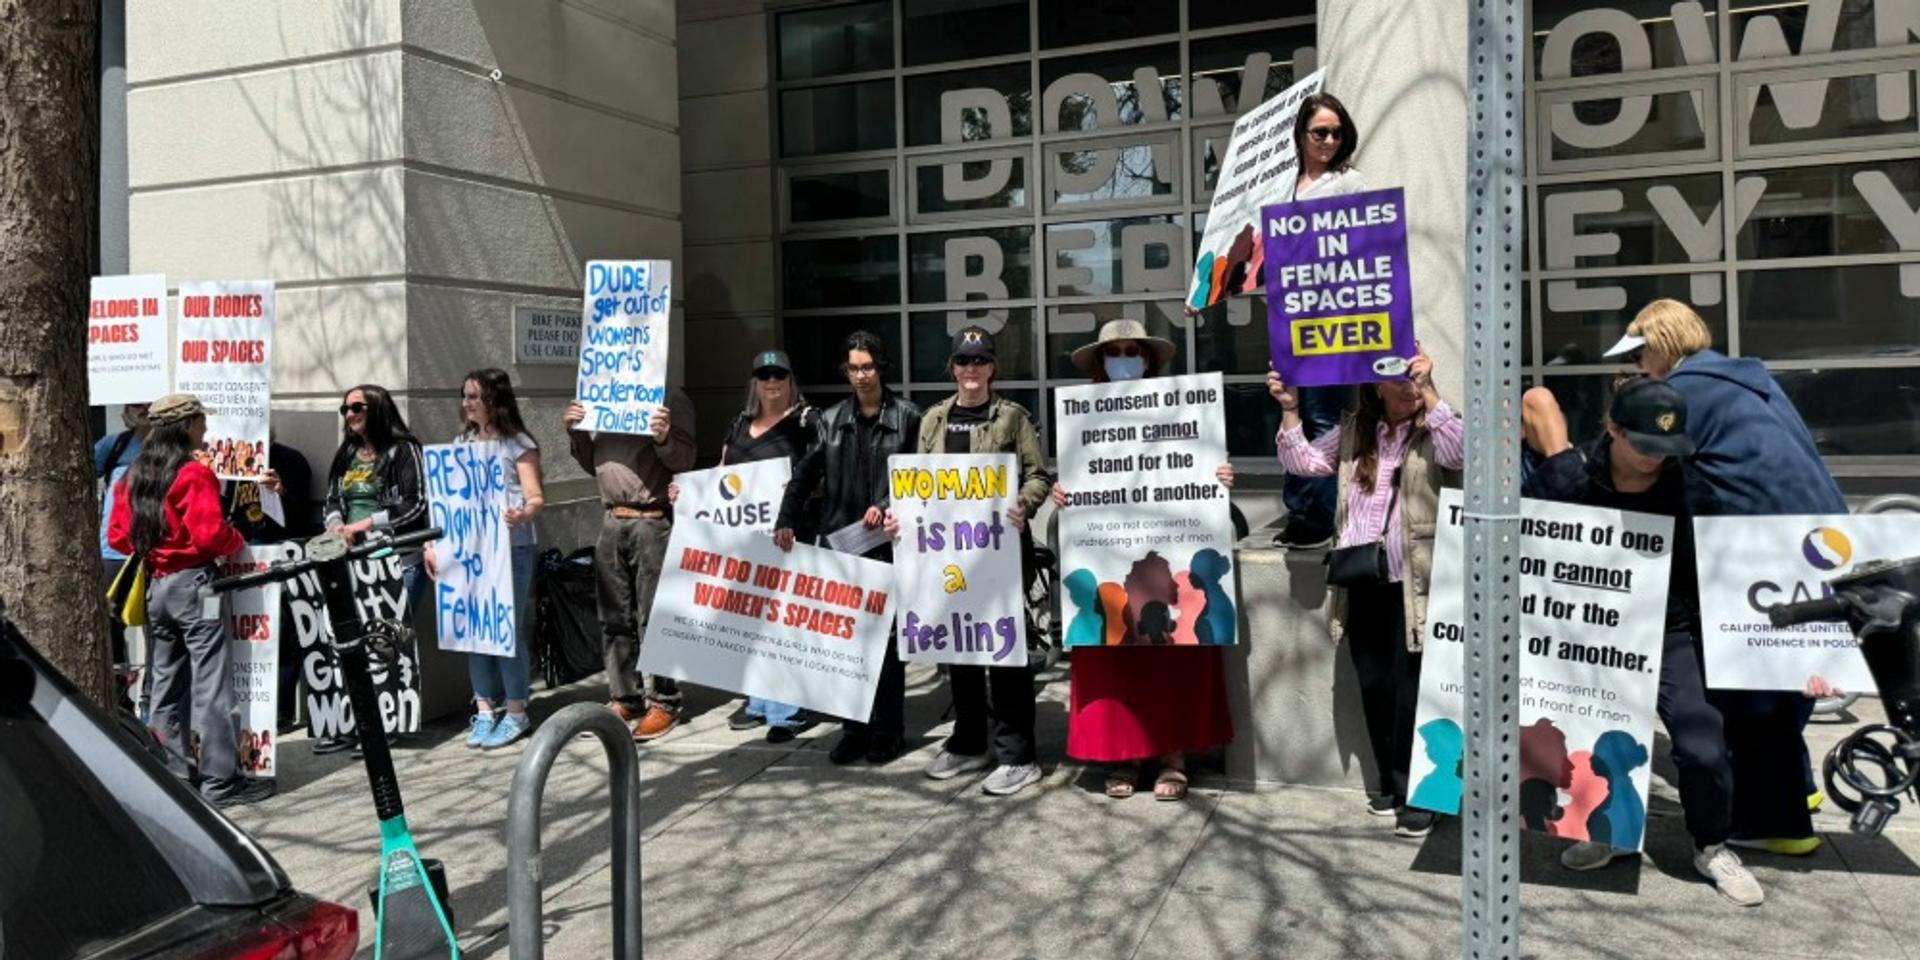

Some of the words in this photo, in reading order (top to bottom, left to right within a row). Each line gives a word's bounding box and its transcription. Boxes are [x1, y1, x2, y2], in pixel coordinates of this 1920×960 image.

[1250, 98, 1287, 128] consent
[1267, 114, 1297, 140] canno
[1214, 181, 1248, 207] consent
[1269, 215, 1307, 237] NO
[1312, 203, 1397, 232] MALES
[1318, 233, 1348, 258] IN
[1281, 256, 1393, 288] FEMALE
[89, 298, 139, 319] ELONG
[142, 297, 158, 316] IN
[184, 295, 210, 318] OUR
[213, 293, 262, 318] BODIES
[592, 296, 621, 323] get
[624, 292, 650, 315] out
[651, 284, 669, 314] of
[1284, 283, 1393, 314] SPACES
[532, 313, 552, 326] BIKE
[88, 324, 139, 344] PACES
[528, 329, 559, 342] PLEASE
[562, 330, 578, 342] DO
[1299, 321, 1383, 349] EVER
[182, 340, 208, 363] OUR
[212, 340, 264, 364] SPACES
[524, 344, 541, 357] USE
[581, 348, 644, 376] Sports
[224, 382, 267, 392] CONSENT
[1063, 398, 1090, 415] The
[1095, 392, 1159, 412] consent
[1164, 389, 1180, 406] of
[1186, 388, 1217, 404] one
[593, 405, 649, 433] Toilets
[1082, 426, 1136, 446] person
[1142, 420, 1199, 441] cannot
[1089, 455, 1133, 474] stand
[1138, 453, 1162, 471] for
[1166, 451, 1193, 469] the
[891, 464, 1008, 503] WOMAN
[1065, 487, 1127, 506] consent
[1132, 486, 1148, 503] of
[1153, 482, 1224, 502] another.
[916, 516, 946, 553] is
[953, 510, 1005, 551] not
[1086, 522, 1103, 532] We
[1106, 521, 1121, 531] do
[1123, 520, 1140, 531] not
[1144, 518, 1186, 530] consent
[1188, 517, 1200, 527] to
[1520, 517, 1583, 538] nsent
[1590, 524, 1613, 547] of
[1620, 530, 1664, 554] one
[1072, 535, 1132, 548] undressing
[1135, 536, 1144, 545] in
[1146, 533, 1171, 545] front
[1174, 532, 1185, 543] of
[1187, 532, 1214, 543] men
[462, 551, 482, 584] to
[680, 547, 722, 577] MEN
[723, 557, 752, 584] DO
[753, 564, 792, 592] NOT
[793, 573, 863, 610] BELONG
[865, 590, 888, 616] IN
[942, 564, 967, 594] a
[1553, 560, 1633, 593] cannot
[693, 582, 781, 622] WOMEN'S
[783, 603, 856, 640] SPACES
[1543, 596, 1576, 620] for
[1582, 602, 1619, 627] the
[704, 636, 715, 647] TO
[717, 640, 746, 654] NAKED
[902, 610, 1017, 662] feeling
[1747, 638, 1805, 648] EVIDENCE
[1808, 639, 1820, 648] IN
[1528, 635, 1552, 658] of
[1558, 641, 1653, 674] another.
[1519, 676, 1534, 687] ot
[1538, 678, 1597, 699] consent
[1601, 688, 1616, 701] to
[308, 688, 420, 738] Woen
[1522, 694, 1536, 706] in
[1539, 698, 1574, 714] front
[1578, 704, 1594, 717] of
[1596, 708, 1631, 723] men
